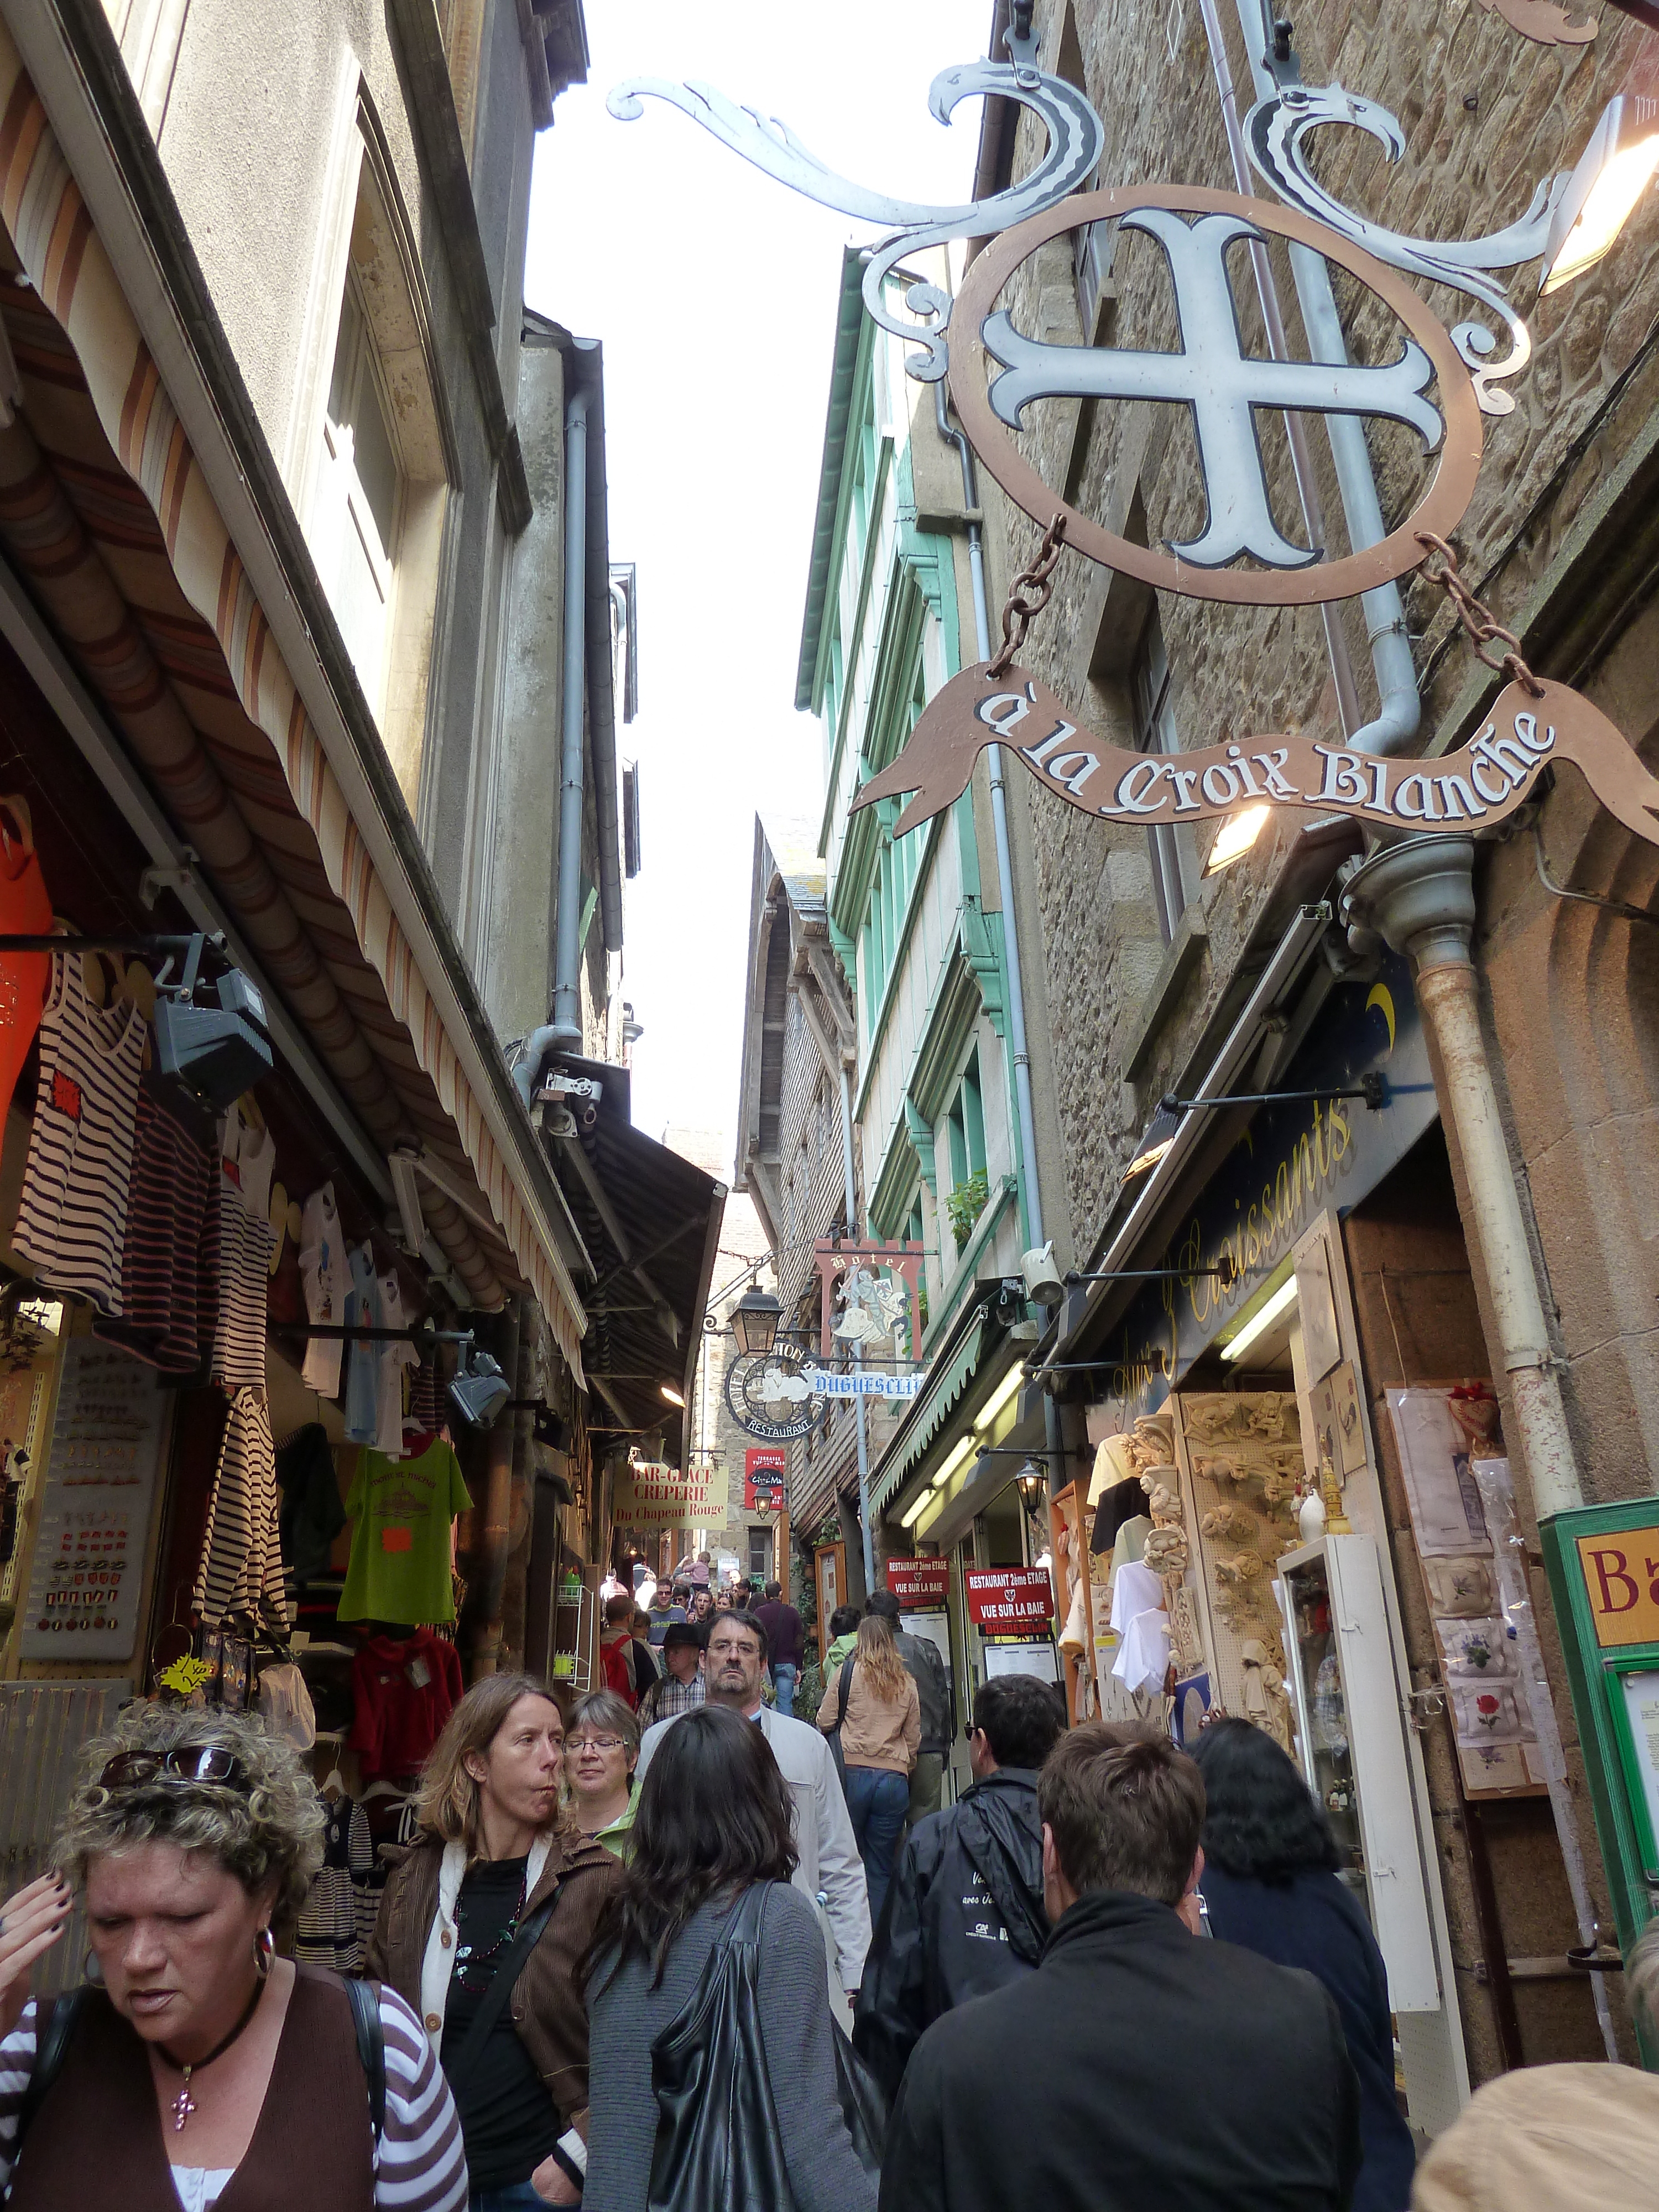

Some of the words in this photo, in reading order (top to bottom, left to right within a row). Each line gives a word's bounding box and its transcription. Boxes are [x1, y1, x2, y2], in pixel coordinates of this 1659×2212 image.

[1018, 719, 1101, 796] la
[1099, 745, 1299, 816] Croix
[1303, 711, 1556, 821] Blanche
[1178, 1087, 1351, 1322] Croissants
[748, 1420, 812, 1437] RESTAURANT
[634, 1484, 708, 1501] CREPERIE
[616, 1508, 632, 1521] Du
[635, 1506, 686, 1522] Chapeau
[689, 1503, 724, 1518] Rouge
[889, 1562, 919, 1572] RESTAURANT
[932, 1561, 947, 1571] ETAGE
[895, 1583, 907, 1593] VUE
[908, 1583, 920, 1593] SUR
[921, 1583, 928, 1592] LA
[930, 1582, 943, 1592] BAIE
[969, 1573, 1009, 1589] RESTAURANT
[1010, 1573, 1027, 1587] 2ème
[1027, 1571, 1047, 1585] ETAGE
[980, 1604, 997, 1619] VUE
[998, 1603, 1015, 1617] SUR
[1015, 1603, 1026, 1616] LA
[1026, 1601, 1045, 1615] BAIE
